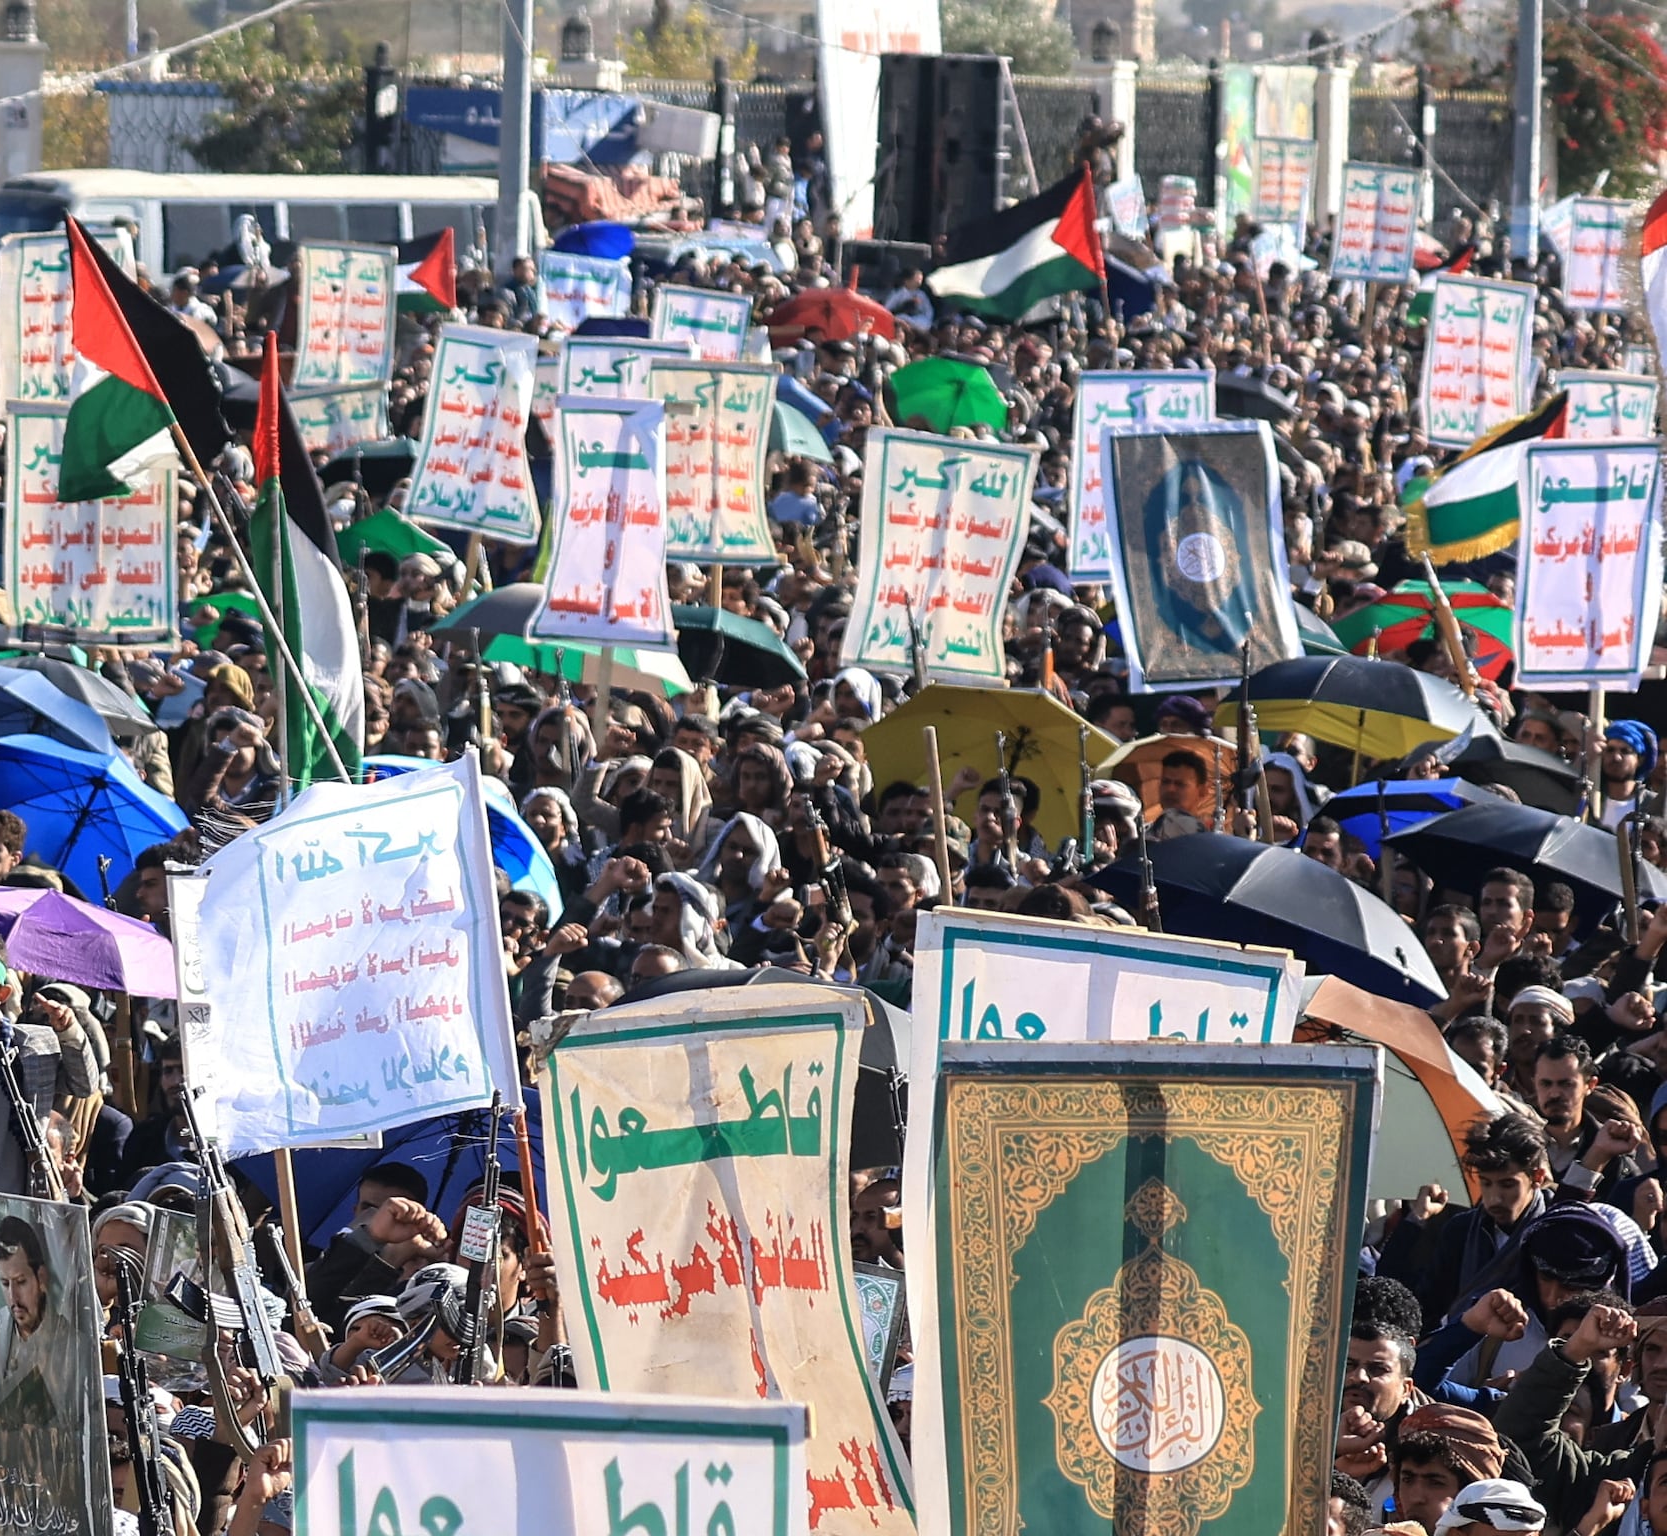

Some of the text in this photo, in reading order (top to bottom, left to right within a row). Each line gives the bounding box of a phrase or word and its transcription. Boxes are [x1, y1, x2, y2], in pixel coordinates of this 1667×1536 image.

[1490, 304, 1523, 327] الله
[1088, 381, 1205, 425] الله أكبر
[1568, 383, 1649, 425] الله أكبر
[891, 457, 1020, 502] الله أكبر
[1536, 463, 1651, 514] قاطعوا
[414, 480, 476, 522] للإسلام
[20, 520, 163, 550] الموت لإسرائيل
[886, 502, 1012, 540] الموت لأمريكا
[19, 561, 162, 590] اللعنة على اليهود
[883, 542, 1003, 579] الموت لإسرائيل
[1585, 572, 1593, 603] و
[101, 598, 162, 632] النصر
[936, 625, 990, 661] النصر
[572, 1066, 822, 1200] قاطعوا
[591, 1200, 830, 1323] البضائع الأمريكية
